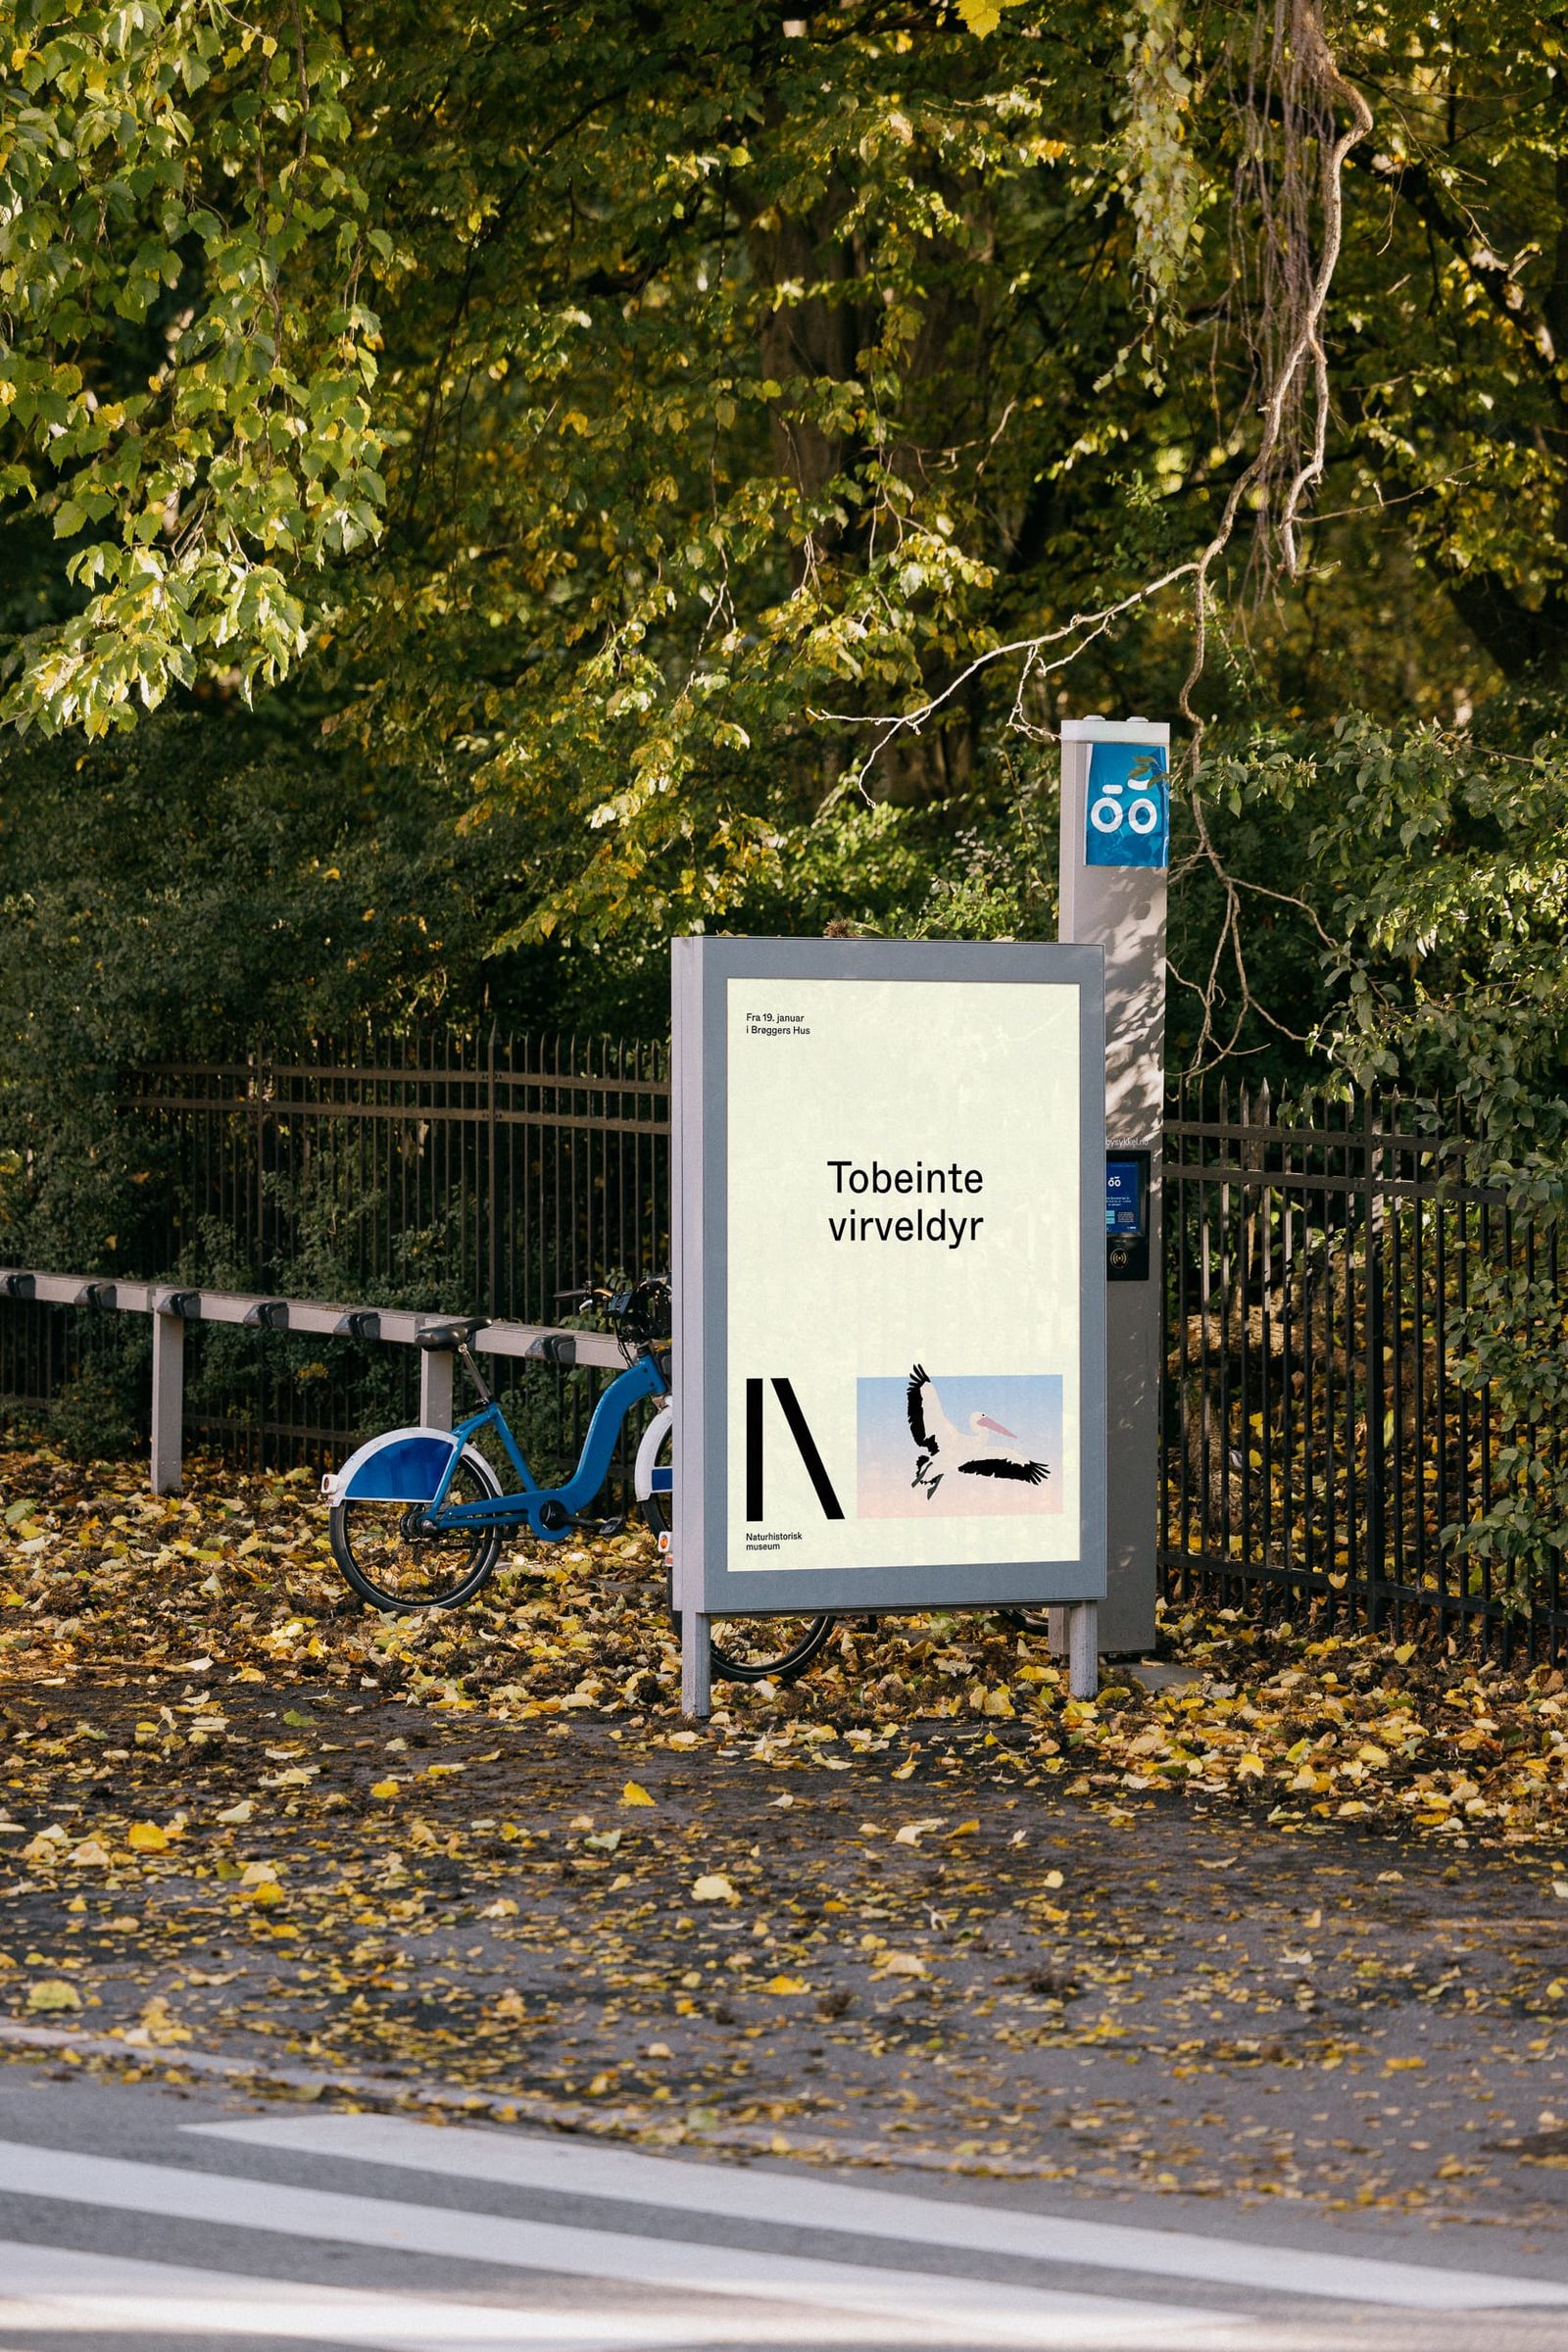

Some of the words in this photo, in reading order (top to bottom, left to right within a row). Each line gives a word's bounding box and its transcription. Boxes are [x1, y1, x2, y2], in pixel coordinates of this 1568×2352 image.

[746, 1012, 761, 1022] Fra
[762, 1012, 775, 1022] 19.
[776, 1012, 806, 1024] januar
[751, 1025, 792, 1037] Brøggers
[793, 1025, 810, 1035] Hus
[827, 1160, 983, 1194] Tobeinte
[828, 1208, 984, 1250] virveldyr
[746, 1531, 803, 1542] Naturhistorisk
